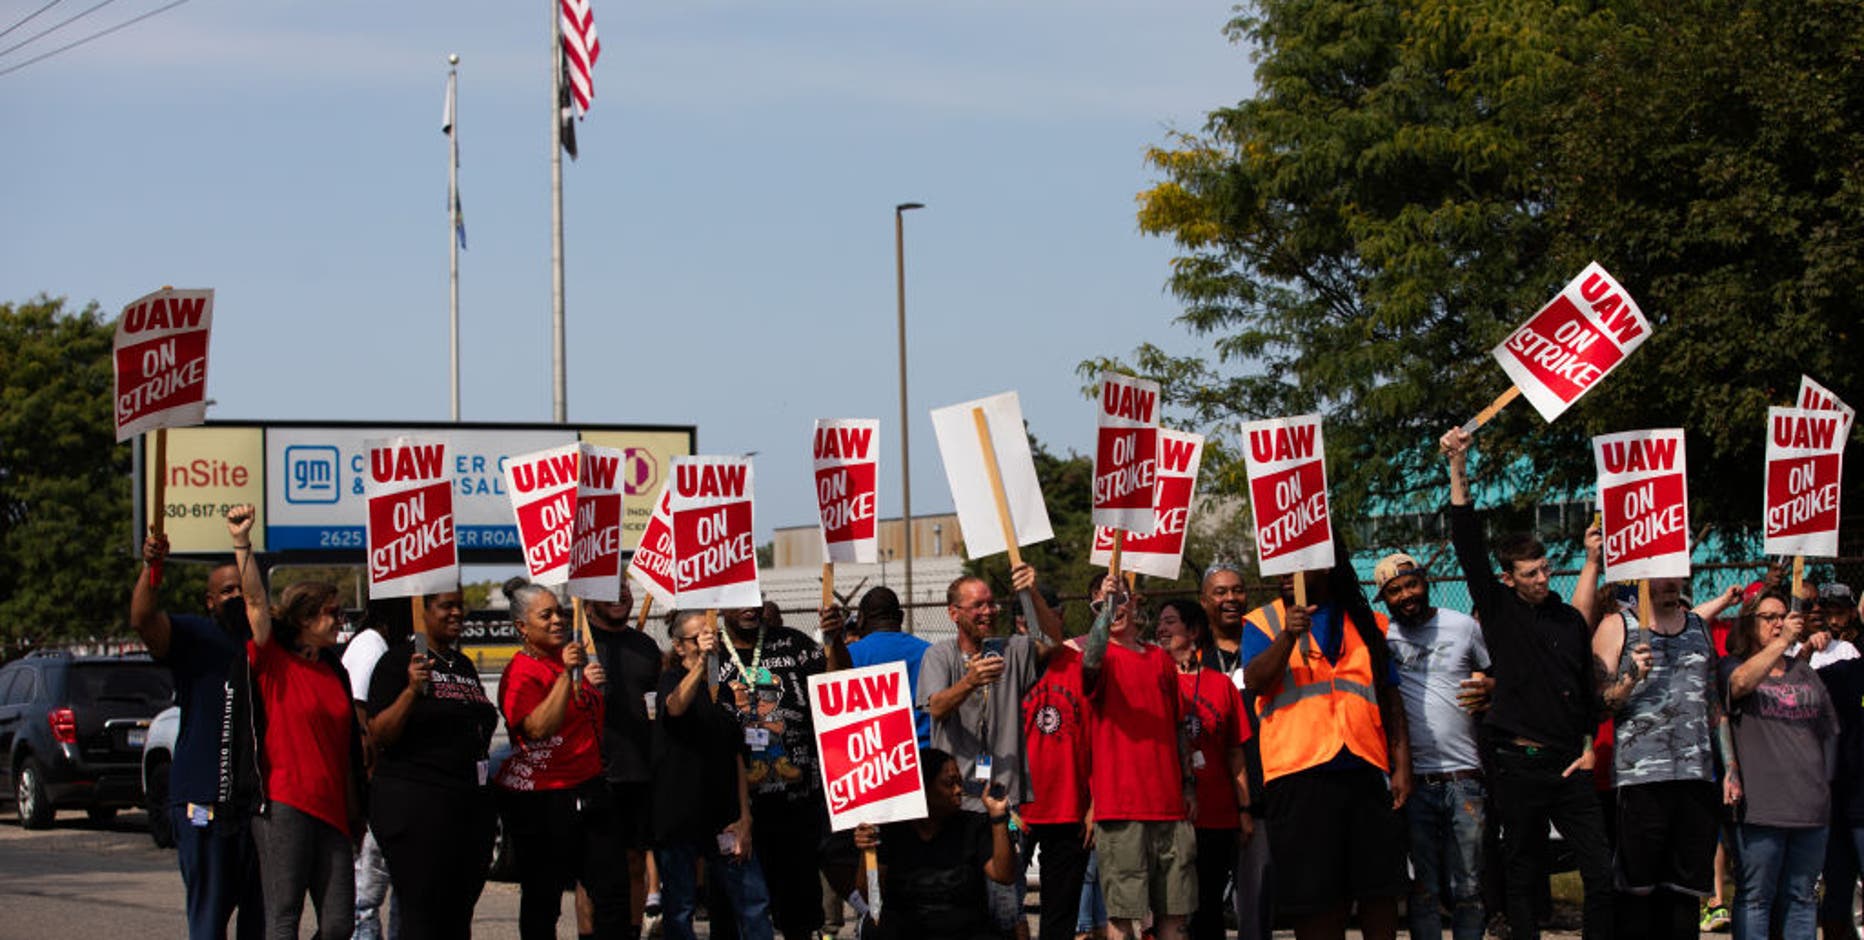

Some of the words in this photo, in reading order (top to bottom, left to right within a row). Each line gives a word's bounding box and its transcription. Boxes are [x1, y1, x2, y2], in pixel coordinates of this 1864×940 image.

[124, 298, 207, 334] UAW
[1580, 272, 1643, 345] UAW
[1554, 319, 1599, 353] ON
[142, 338, 175, 378] ON
[1509, 327, 1602, 388] STRIKE
[118, 357, 205, 423] STRIKE
[1104, 381, 1155, 423] UAW
[1113, 432, 1136, 467] ON
[1250, 424, 1315, 463] UAW
[1774, 416, 1837, 450] UAW
[294, 459, 330, 489] gm
[371, 444, 445, 484] UAW
[512, 453, 578, 493] UAW
[1602, 439, 1677, 474] UAW
[676, 464, 747, 498] UAW
[819, 469, 847, 505] ON
[1095, 458, 1155, 505] STRIKE
[1275, 471, 1301, 511] ON
[1789, 460, 1815, 495] ON
[393, 492, 425, 533] ON
[541, 494, 571, 531] ON
[1624, 482, 1655, 520] ON
[1768, 482, 1838, 535] STRIKE
[320, 531, 361, 546] 2625
[483, 531, 519, 546] ROA
[696, 509, 728, 546] ON
[1257, 491, 1326, 556] STRIKE
[1606, 503, 1684, 562] STRIKE
[371, 513, 453, 579] STRIKE
[677, 531, 753, 589] STRIKE
[817, 672, 900, 717] UAW
[847, 721, 883, 763] ON
[829, 739, 917, 811] STRIKE
